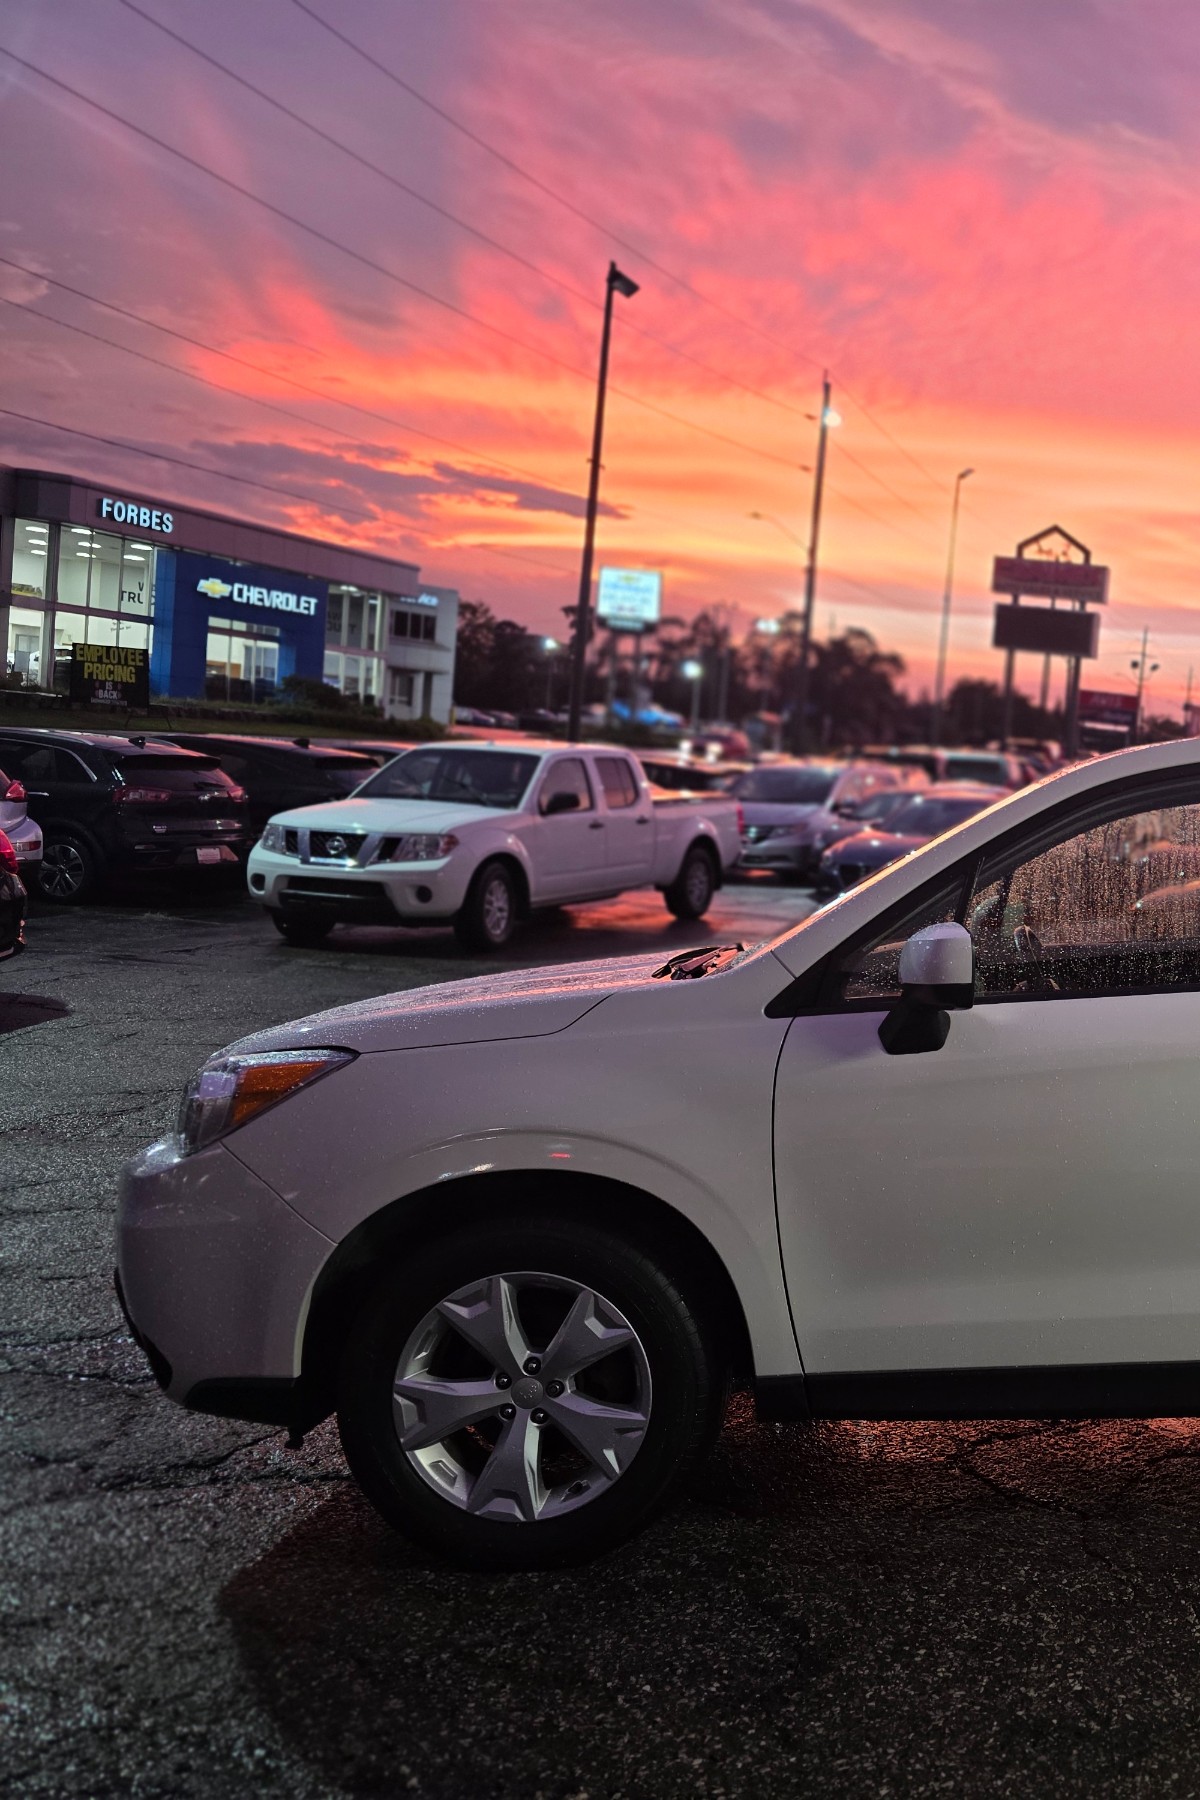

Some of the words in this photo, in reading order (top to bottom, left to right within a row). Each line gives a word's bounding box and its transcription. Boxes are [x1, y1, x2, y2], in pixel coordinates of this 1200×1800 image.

[101, 498, 174, 533] FORBES
[232, 582, 319, 617] CHEVROLET
[75, 643, 144, 666] EMPLOYEE
[83, 662, 136, 683] PRICING
[98, 688, 118, 700] BACK
[105, 681, 113, 690] IS
